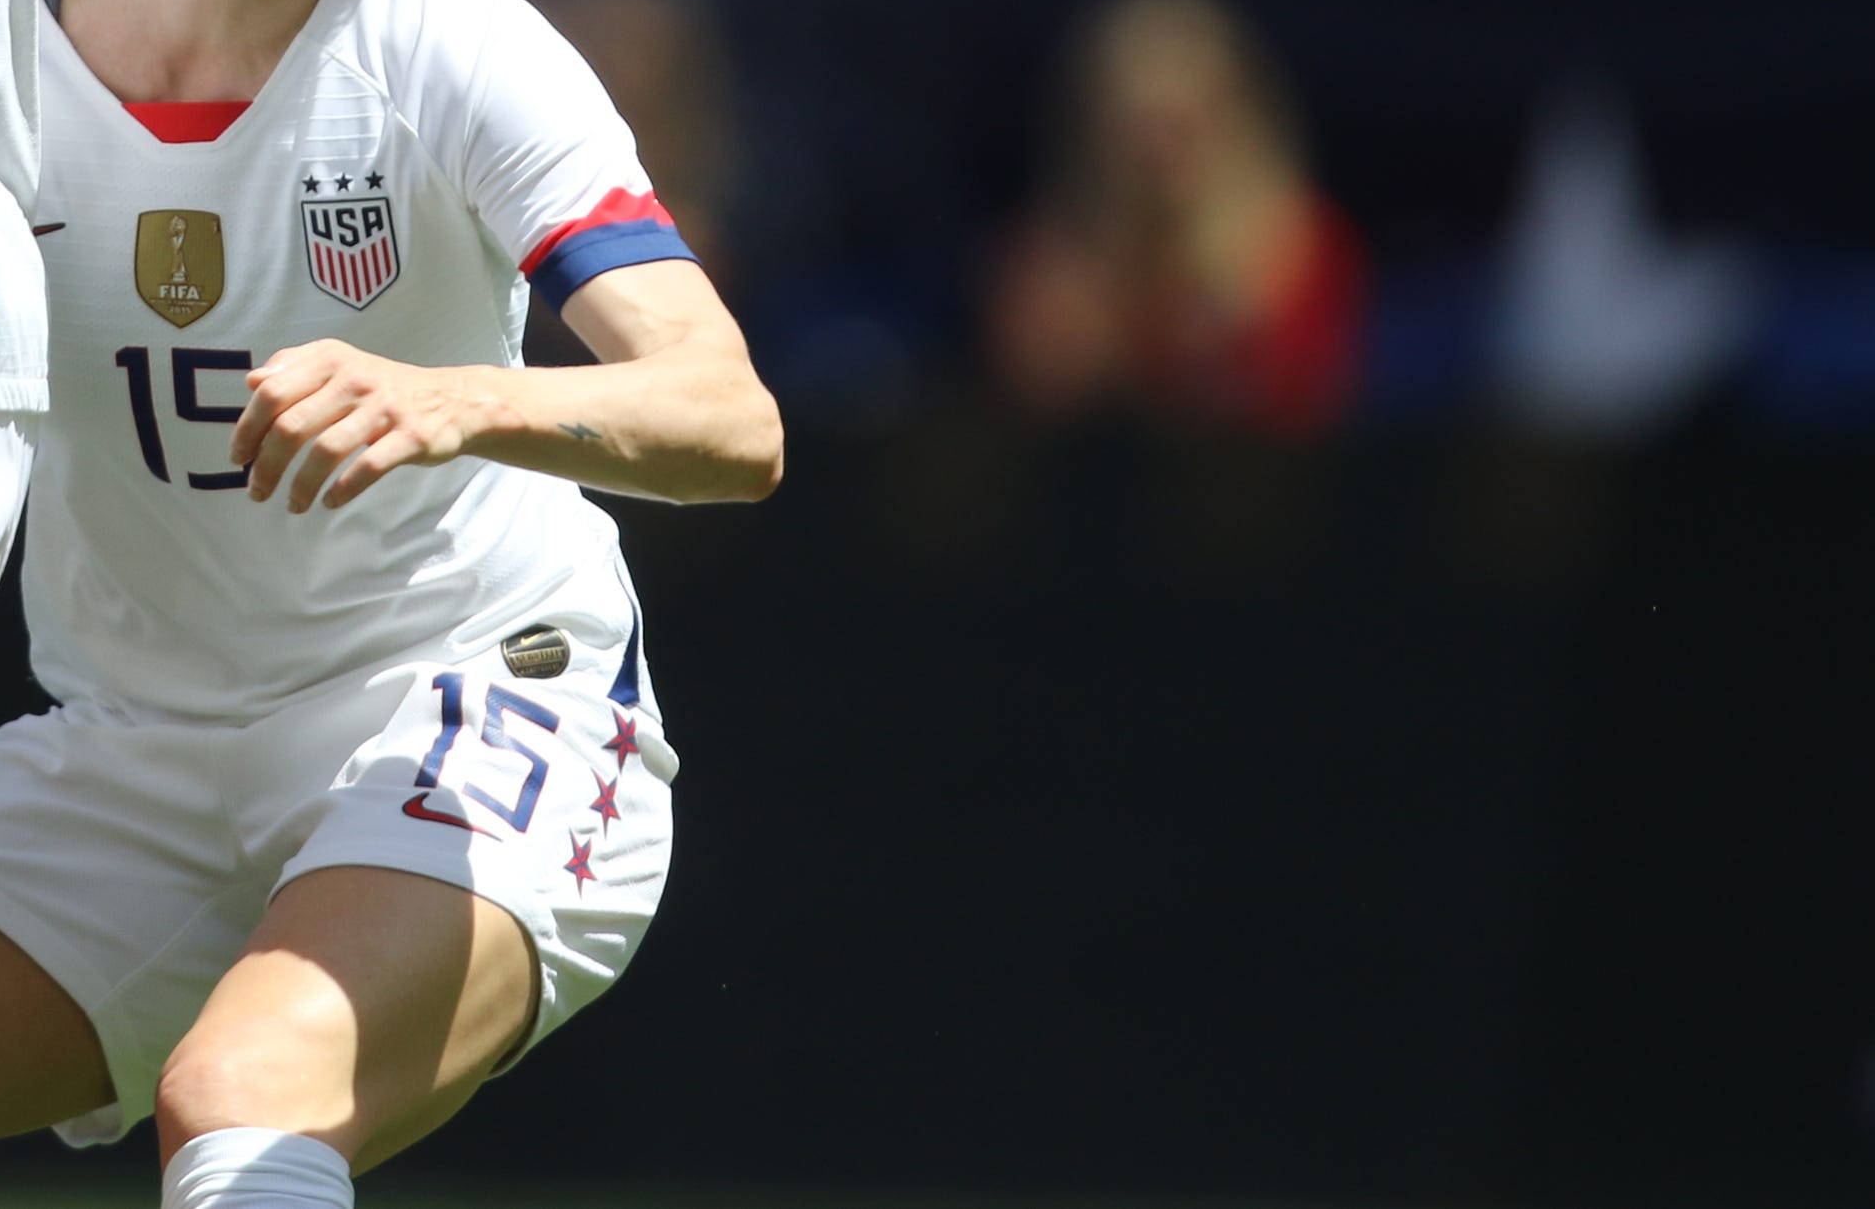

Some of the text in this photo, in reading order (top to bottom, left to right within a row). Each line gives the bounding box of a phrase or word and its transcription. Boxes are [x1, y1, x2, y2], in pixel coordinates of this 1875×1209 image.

[310, 205, 385, 248] USA
[159, 284, 200, 300] FIFA
[115, 346, 255, 491] 15
[414, 672, 560, 834] 15
